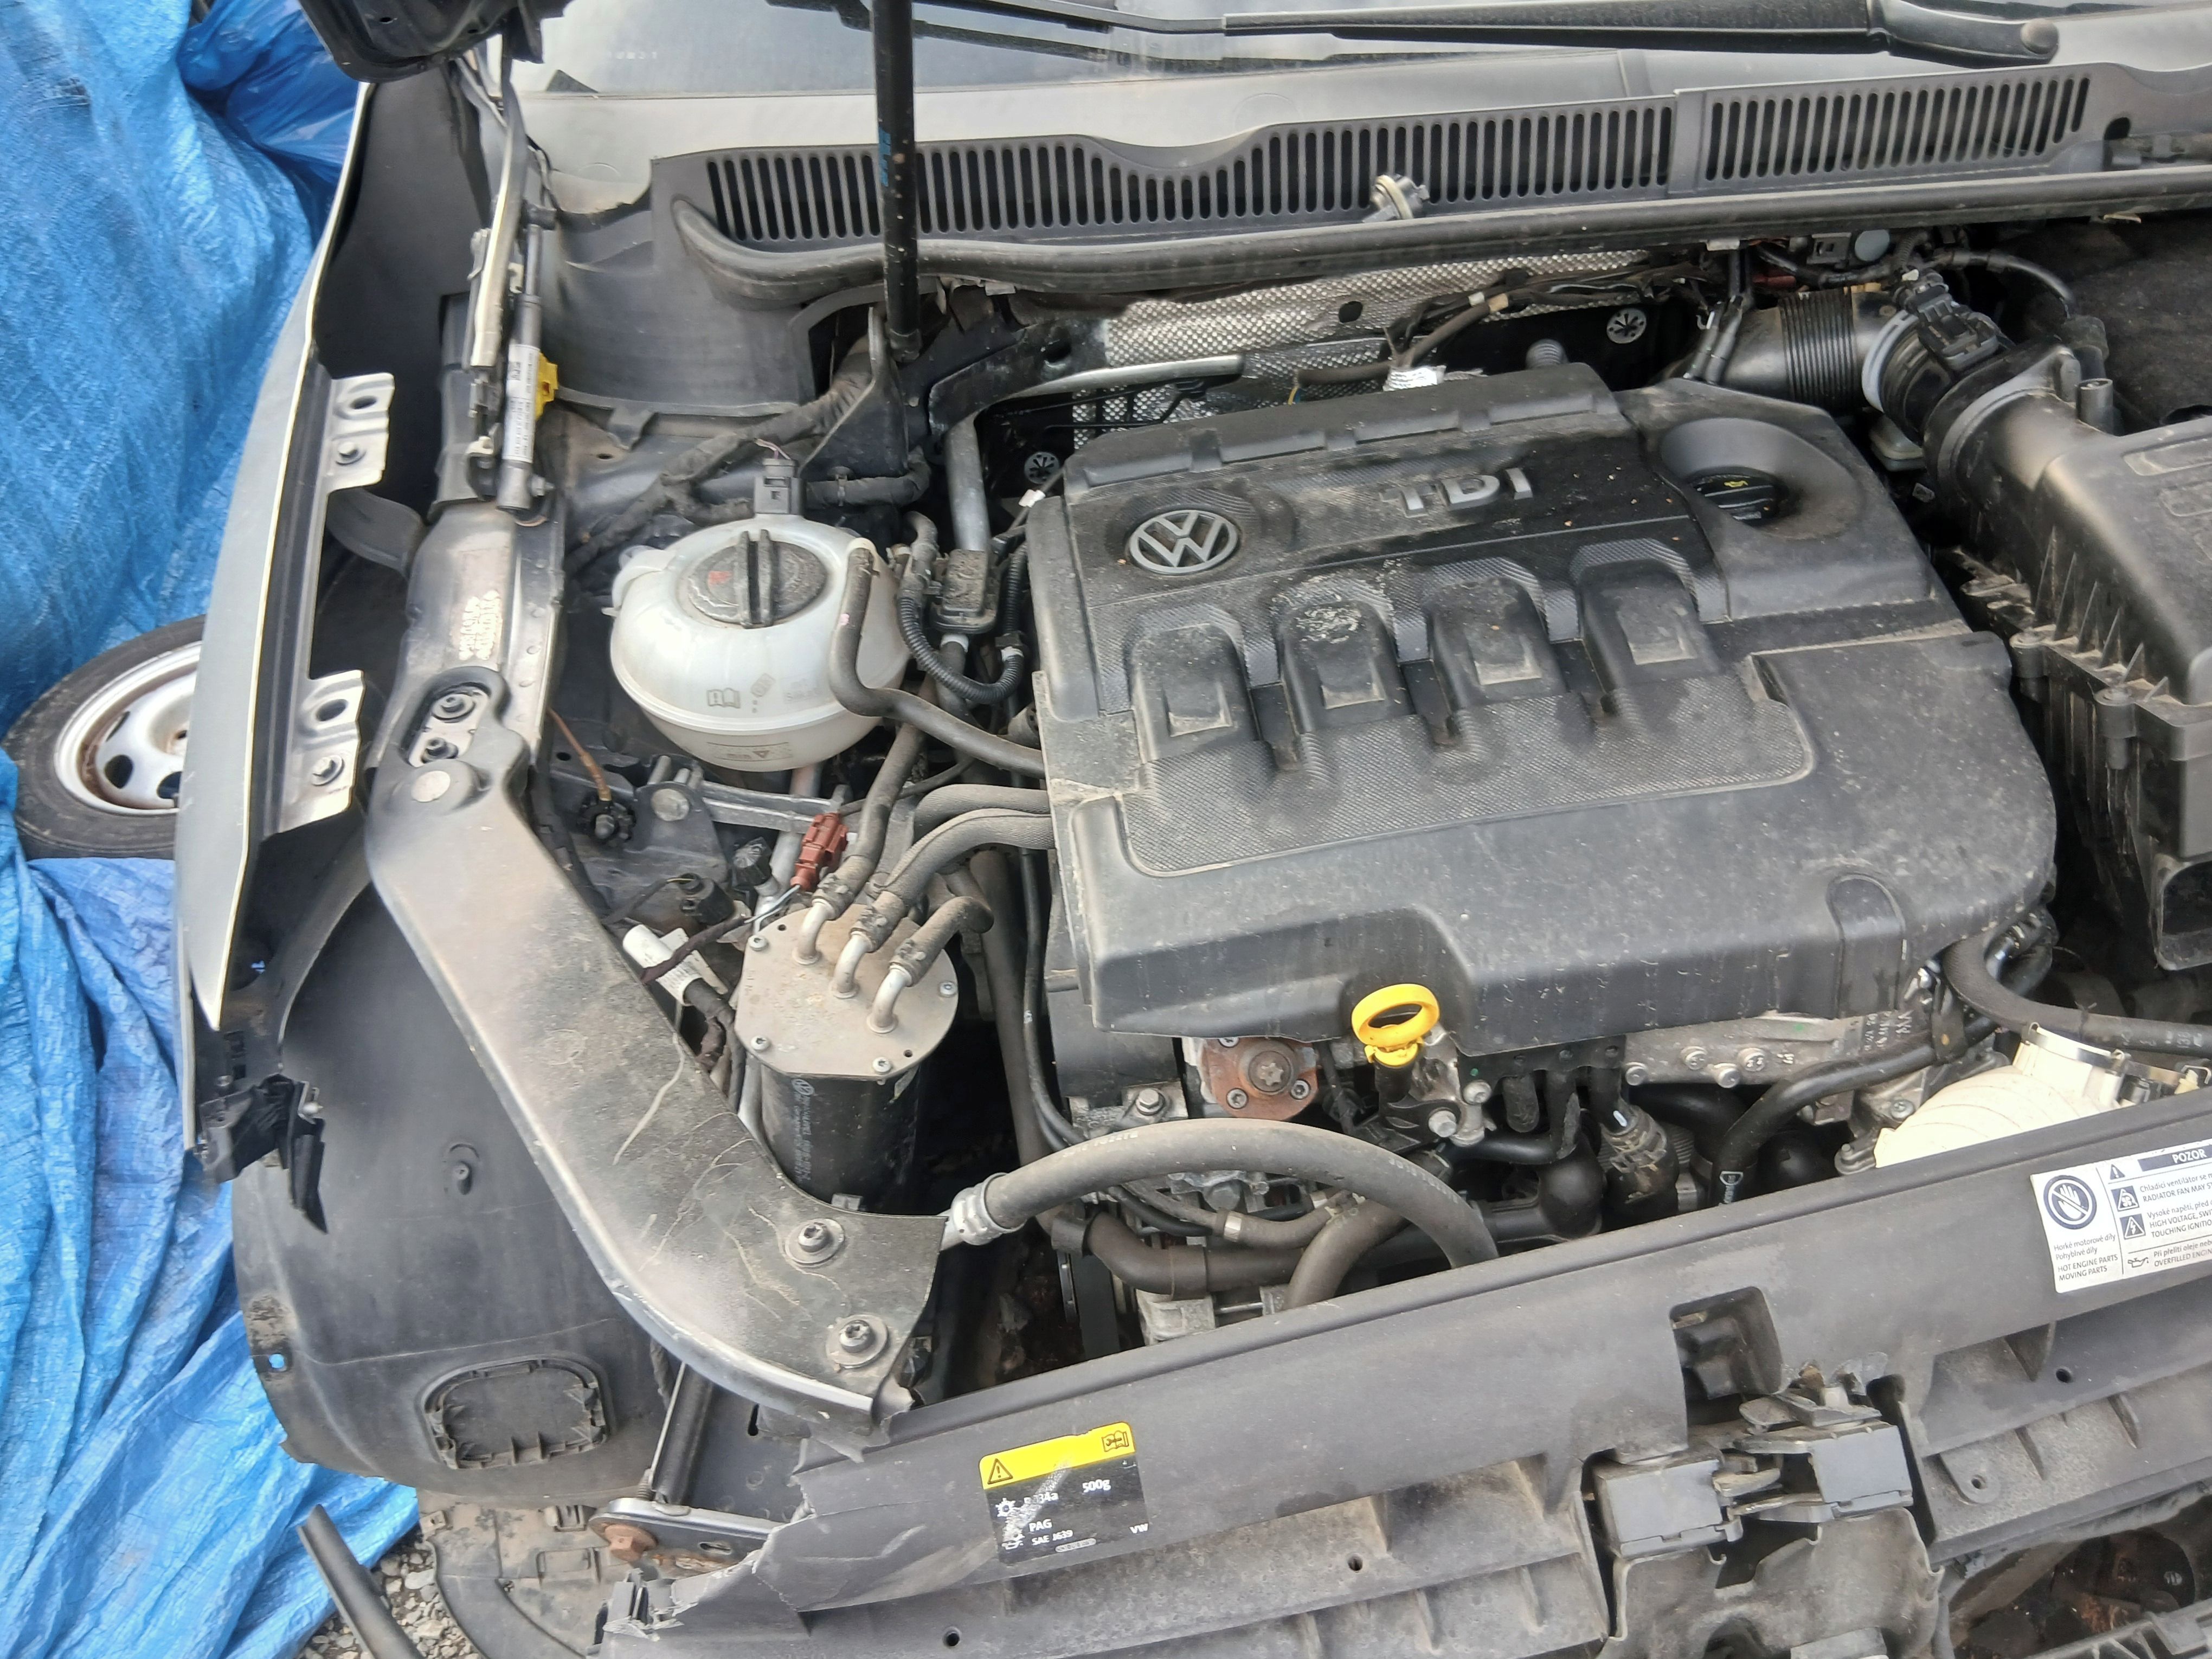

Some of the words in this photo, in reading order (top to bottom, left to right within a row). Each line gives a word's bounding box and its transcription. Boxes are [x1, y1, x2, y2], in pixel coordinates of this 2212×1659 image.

[1380, 467, 1534, 518] TDI
[2171, 1148, 2207, 1163] POZOR
[2143, 1190, 2176, 1202] RADIATOR
[2177, 1187, 2190, 1195] FAN
[2191, 1184, 2205, 1192] MAY
[2149, 1219, 2167, 1228] HIGH
[2168, 1213, 2198, 1224] VOLTAGE,
[2151, 1225, 2186, 1238] TOUCHING
[2183, 1243, 2198, 1251] oleje
[2058, 1264, 2071, 1272] HOT
[2073, 1258, 2098, 1269] ENGINE
[2099, 1254, 2118, 1264] PARTS
[2155, 1253, 2191, 1266] OVERFILLED
[2059, 1270, 2087, 1281] MOVING
[2088, 1265, 2107, 1275] PARTS
[1082, 1479, 1111, 1493] 500g
[1029, 1519, 1052, 1532] PAG
[1129, 1523, 1149, 1534] VW
[1031, 1535, 1050, 1545] SAE
